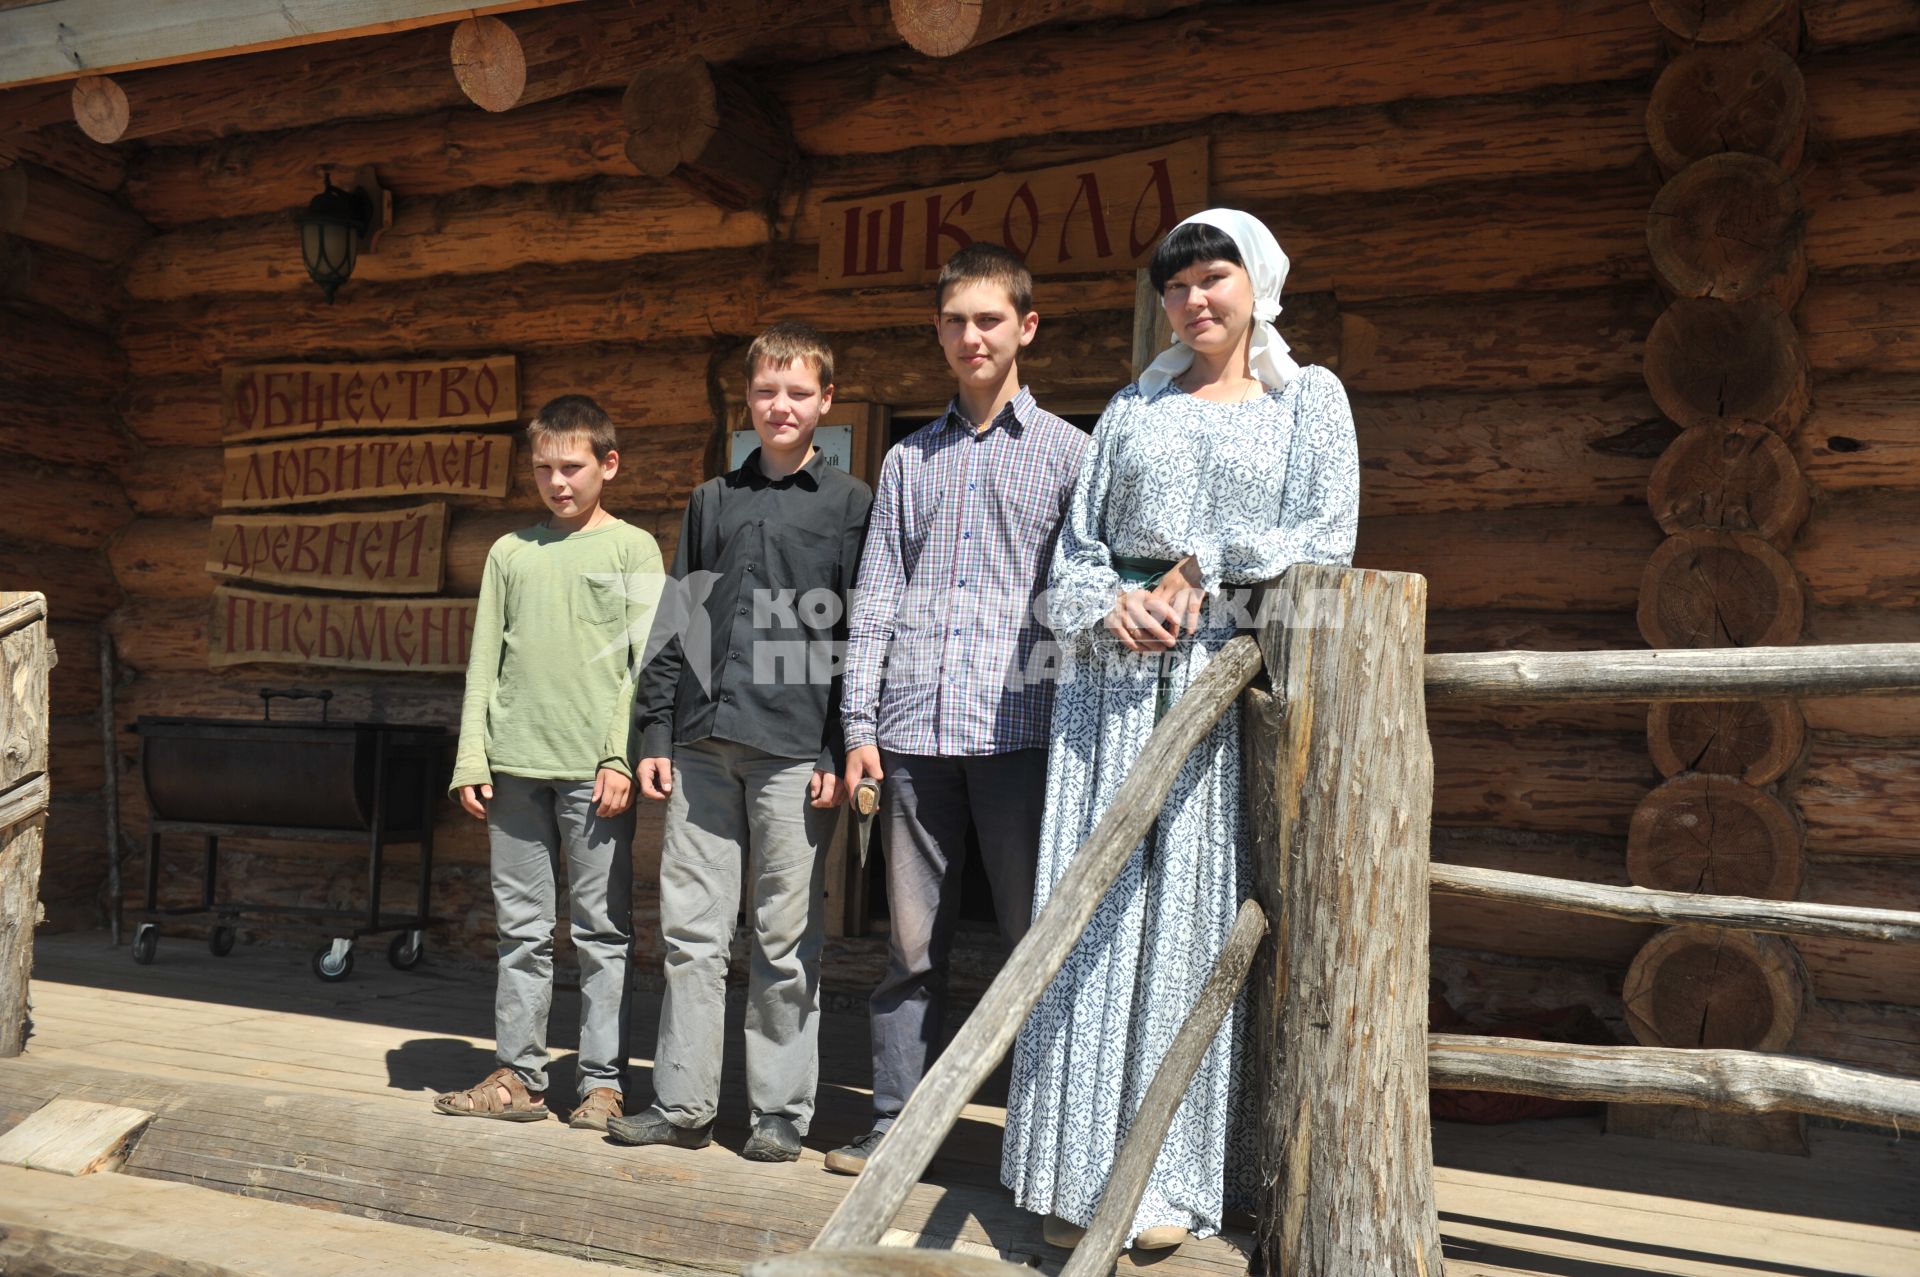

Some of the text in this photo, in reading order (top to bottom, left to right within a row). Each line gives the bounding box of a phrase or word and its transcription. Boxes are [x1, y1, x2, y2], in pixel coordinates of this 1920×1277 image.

[842, 158, 1178, 277] ШКОЛА
[236, 362, 499, 430] ОБЩЕСТВО
[242, 435, 494, 501] ЛЮБИТЕЛЕЙ
[222, 511, 428, 580] ДРЕВНЕЙ
